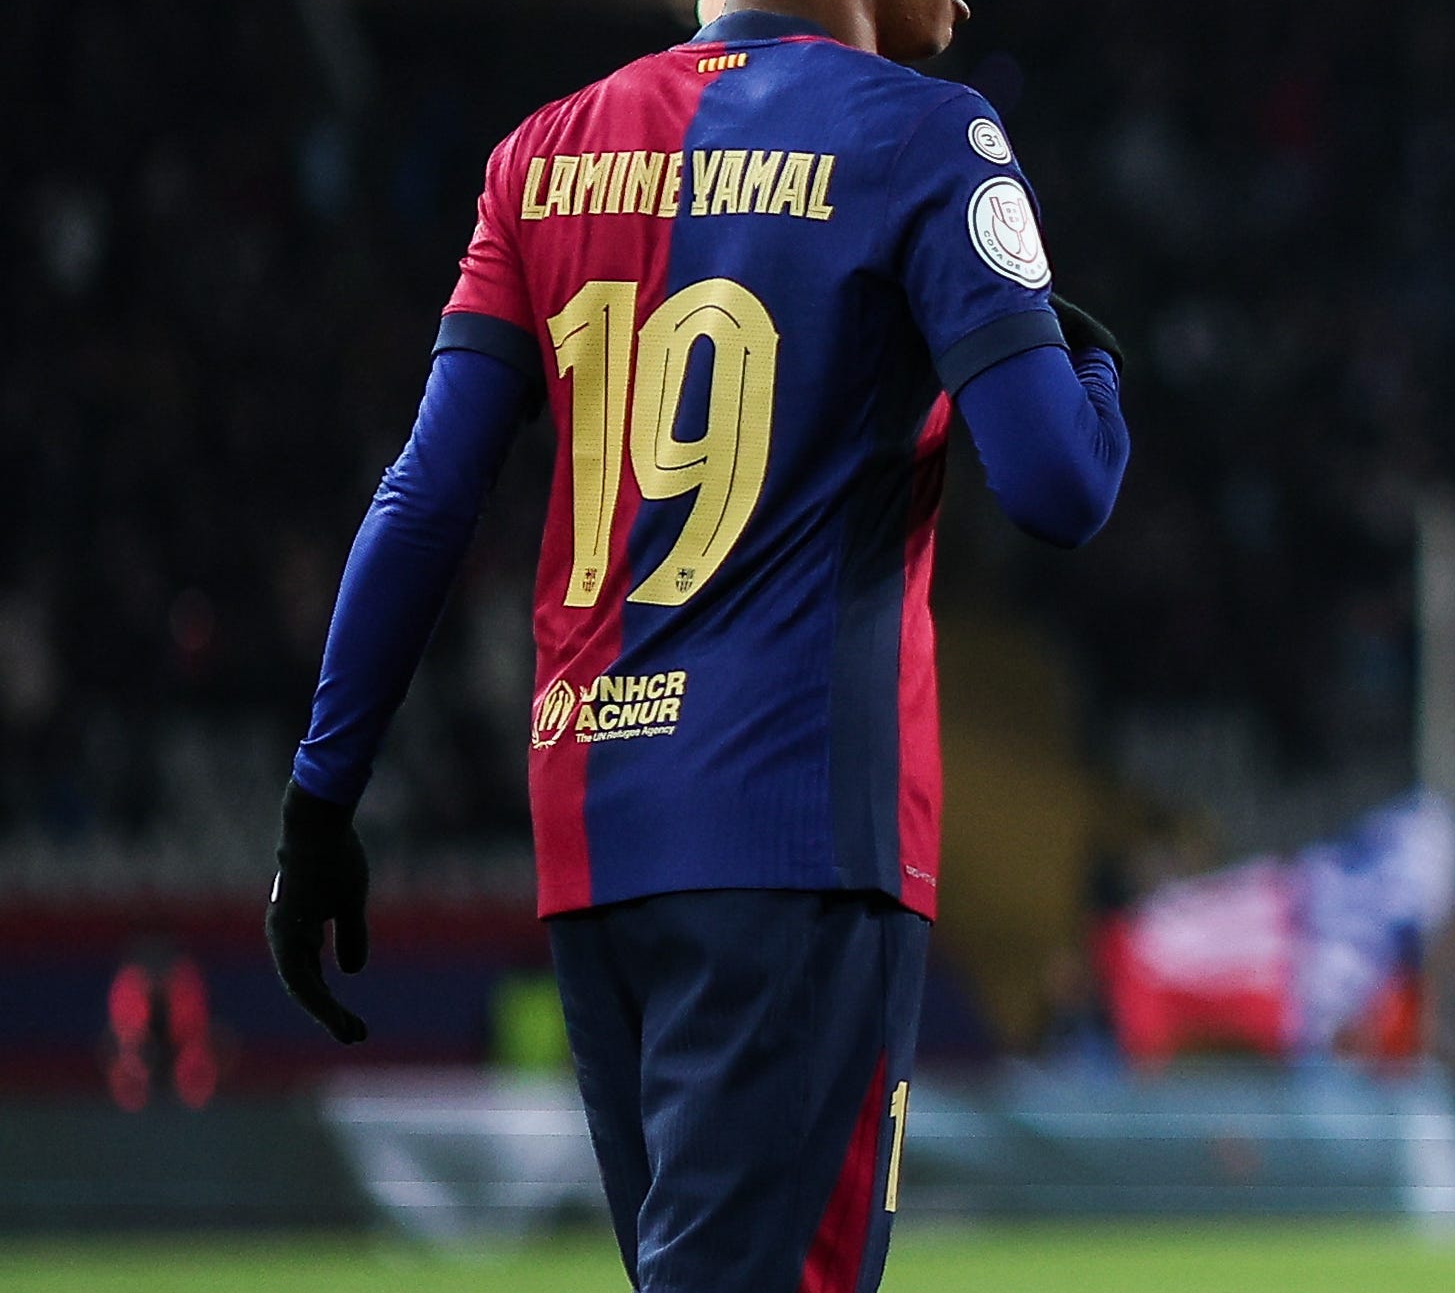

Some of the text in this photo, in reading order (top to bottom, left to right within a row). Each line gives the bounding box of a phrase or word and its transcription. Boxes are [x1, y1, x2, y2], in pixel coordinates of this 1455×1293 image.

[520, 149, 836, 221] LAMINE YAMAL
[547, 278, 779, 608] 19
[580, 671, 687, 703] UNHCR
[574, 697, 681, 732] ACNUR
